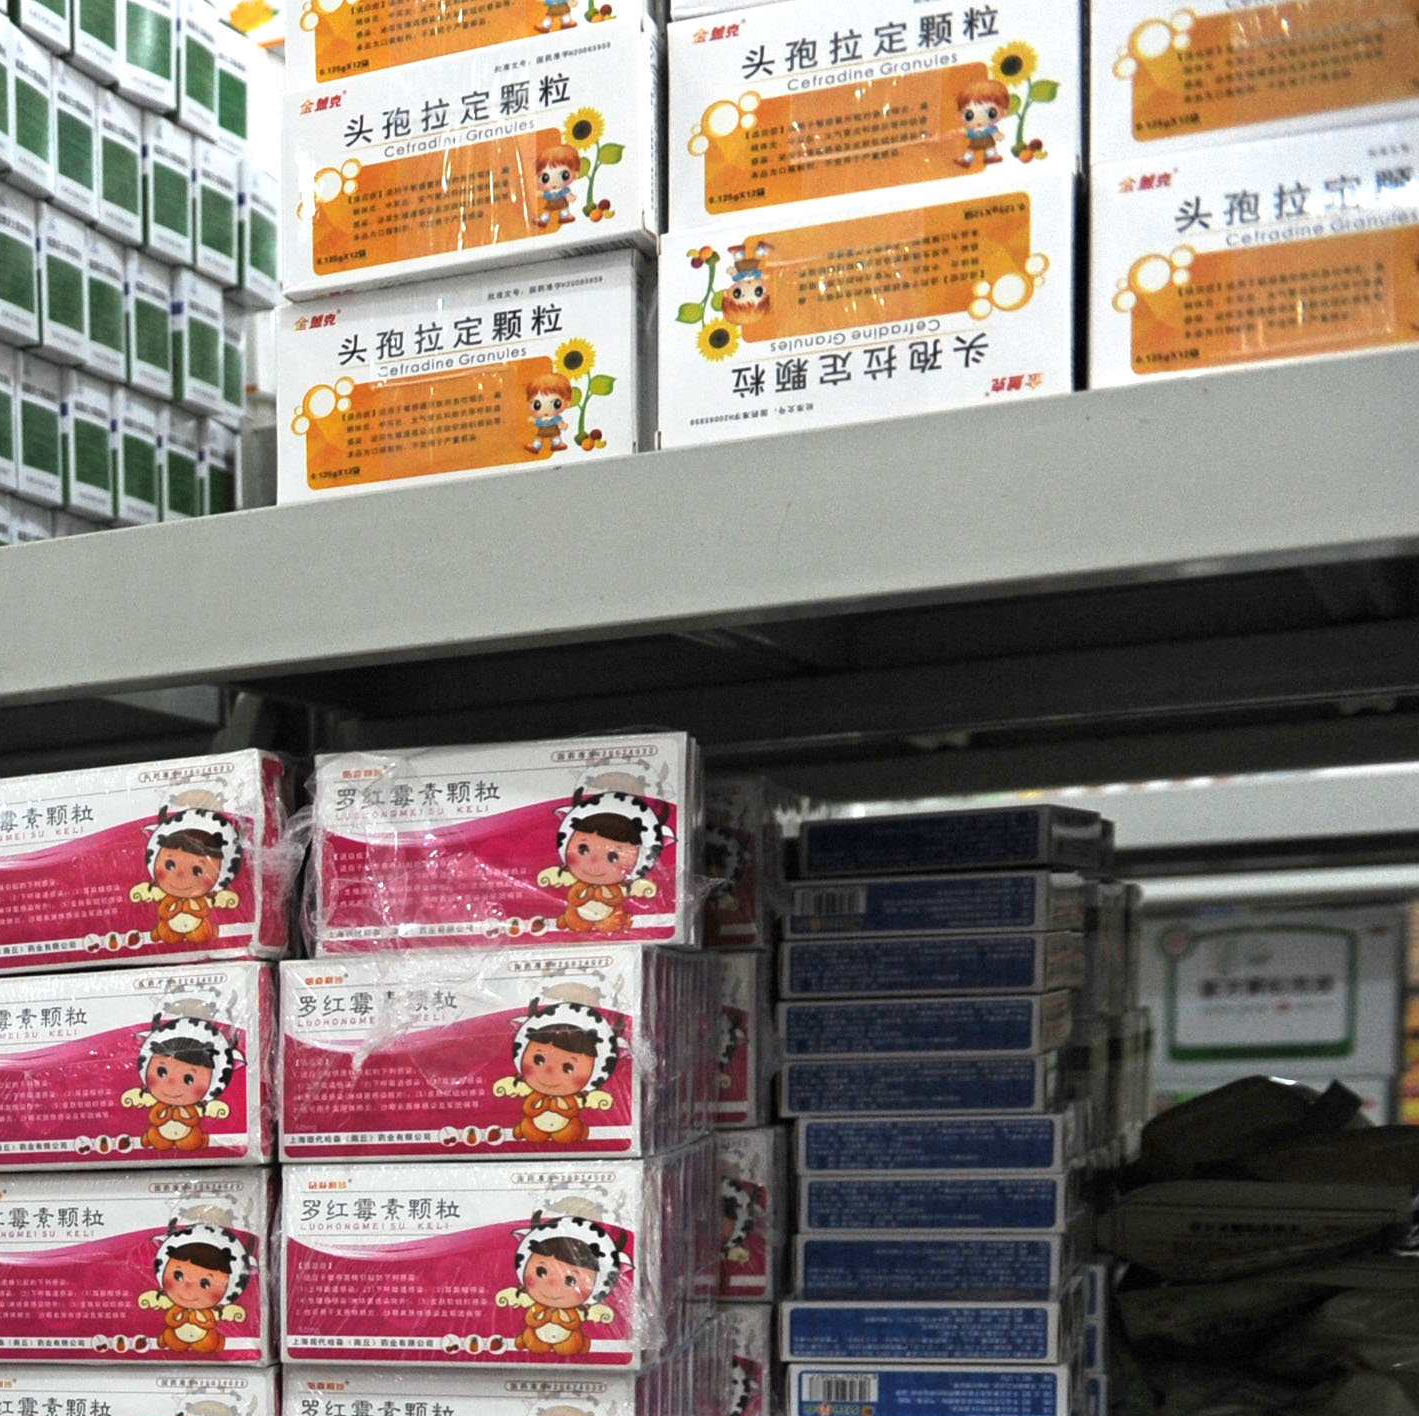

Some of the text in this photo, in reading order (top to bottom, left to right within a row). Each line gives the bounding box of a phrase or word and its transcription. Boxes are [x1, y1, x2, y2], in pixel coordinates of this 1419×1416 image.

[741, 5, 1000, 80] 头孢拉定颗粒
[787, 52, 958, 92] Cefradine Granules
[344, 73, 571, 147] 头孢拉定颗粒
[466, 118, 535, 142] Granules
[1227, 221, 1323, 246] Cefradine
[338, 304, 564, 366] 头孢拉定颗粒
[771, 319, 940, 353] Cefradine Granules
[459, 346, 527, 366] Granules
[732, 333, 989, 398] 头孢拉定颗粒
[335, 781, 501, 811] 罗红霉素颗粒
[457, 805, 489, 814] KELI
[56, 826, 84, 837] KELI
[49, 1029, 78, 1038] KELI
[297, 1016, 376, 1028] LUOHONGME
[300, 1198, 461, 1221] 罗红霉素颗粒
[66, 1230, 94, 1238] KELI
[418, 1222, 450, 1231] KELI
